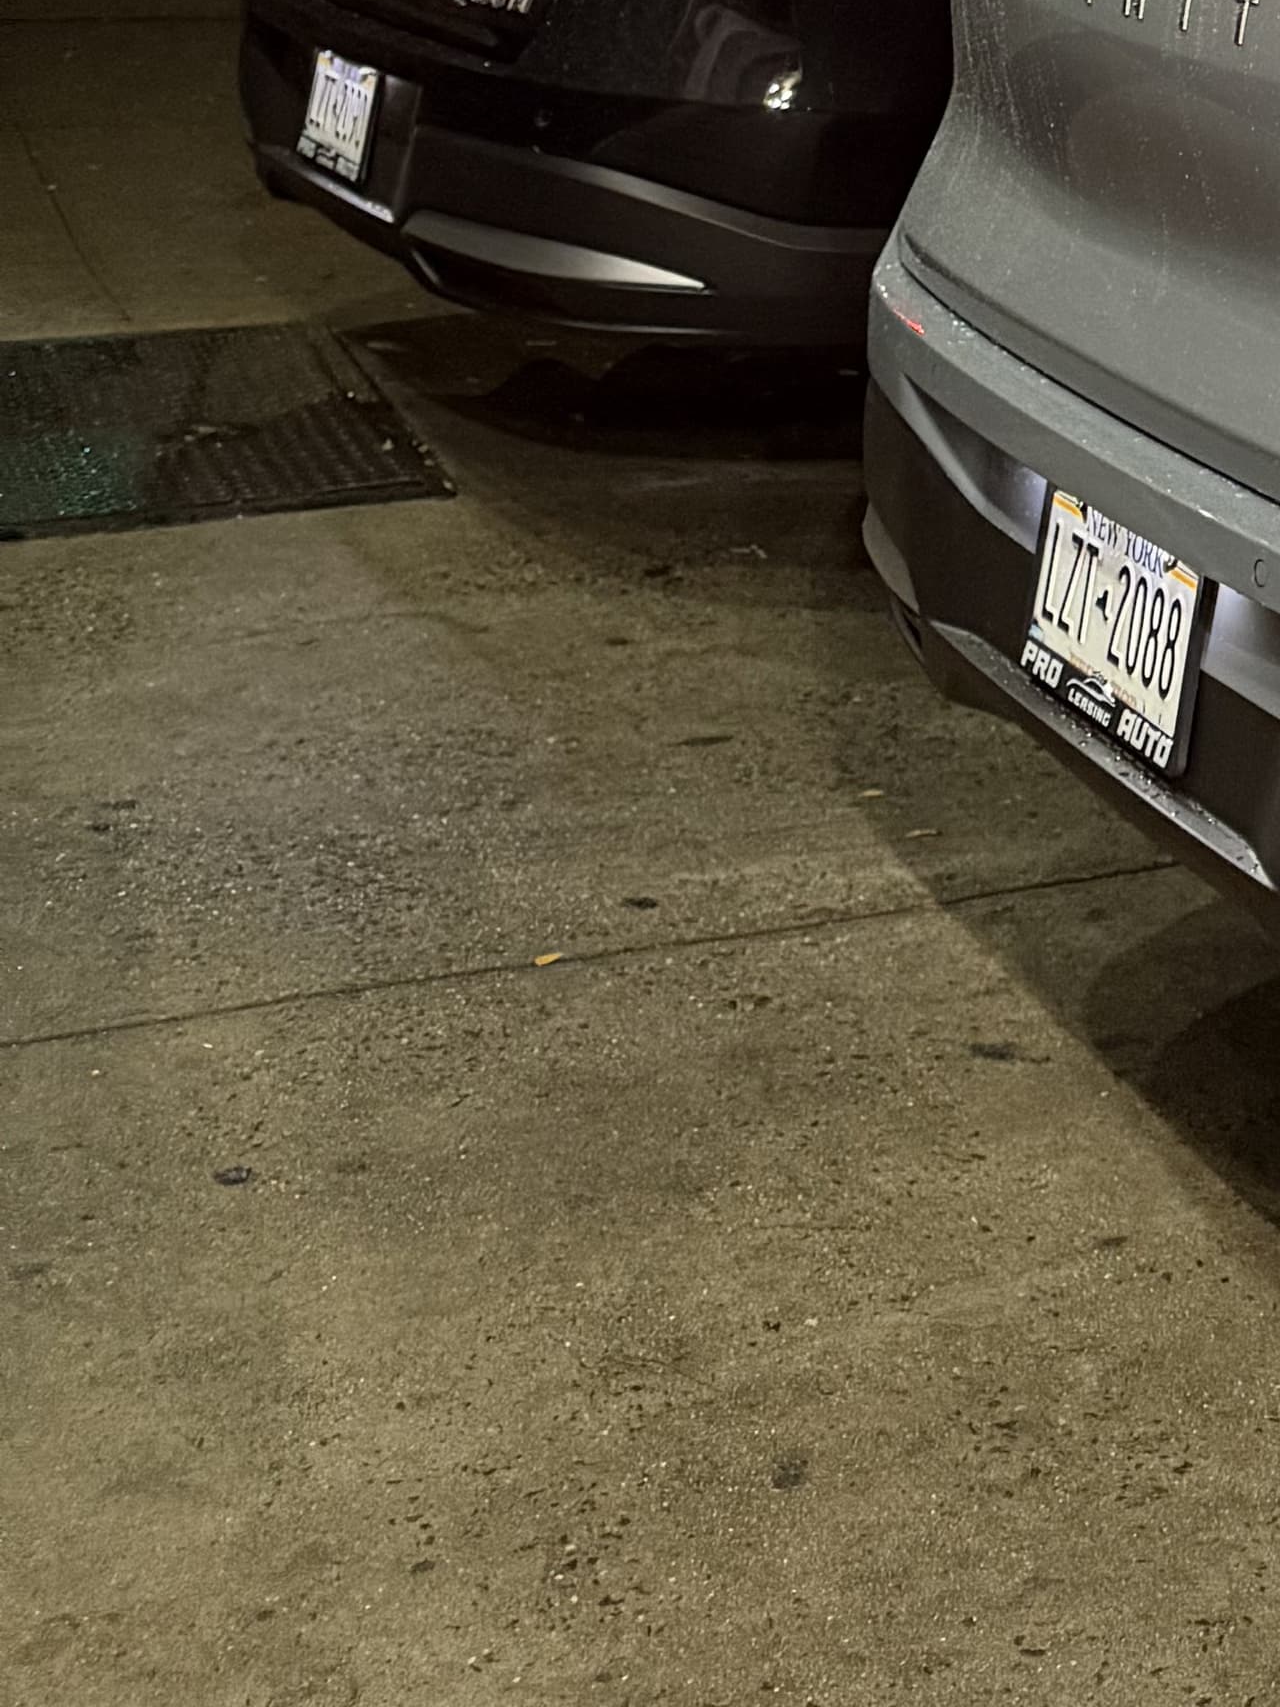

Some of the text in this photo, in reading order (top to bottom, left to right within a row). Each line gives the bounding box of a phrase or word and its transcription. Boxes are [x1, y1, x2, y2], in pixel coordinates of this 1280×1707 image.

[1086, 506, 1165, 579] NEW YORK
[1020, 640, 1065, 690] PRO
[1115, 707, 1175, 769] AUTO
[1066, 688, 1112, 727] LEASING
